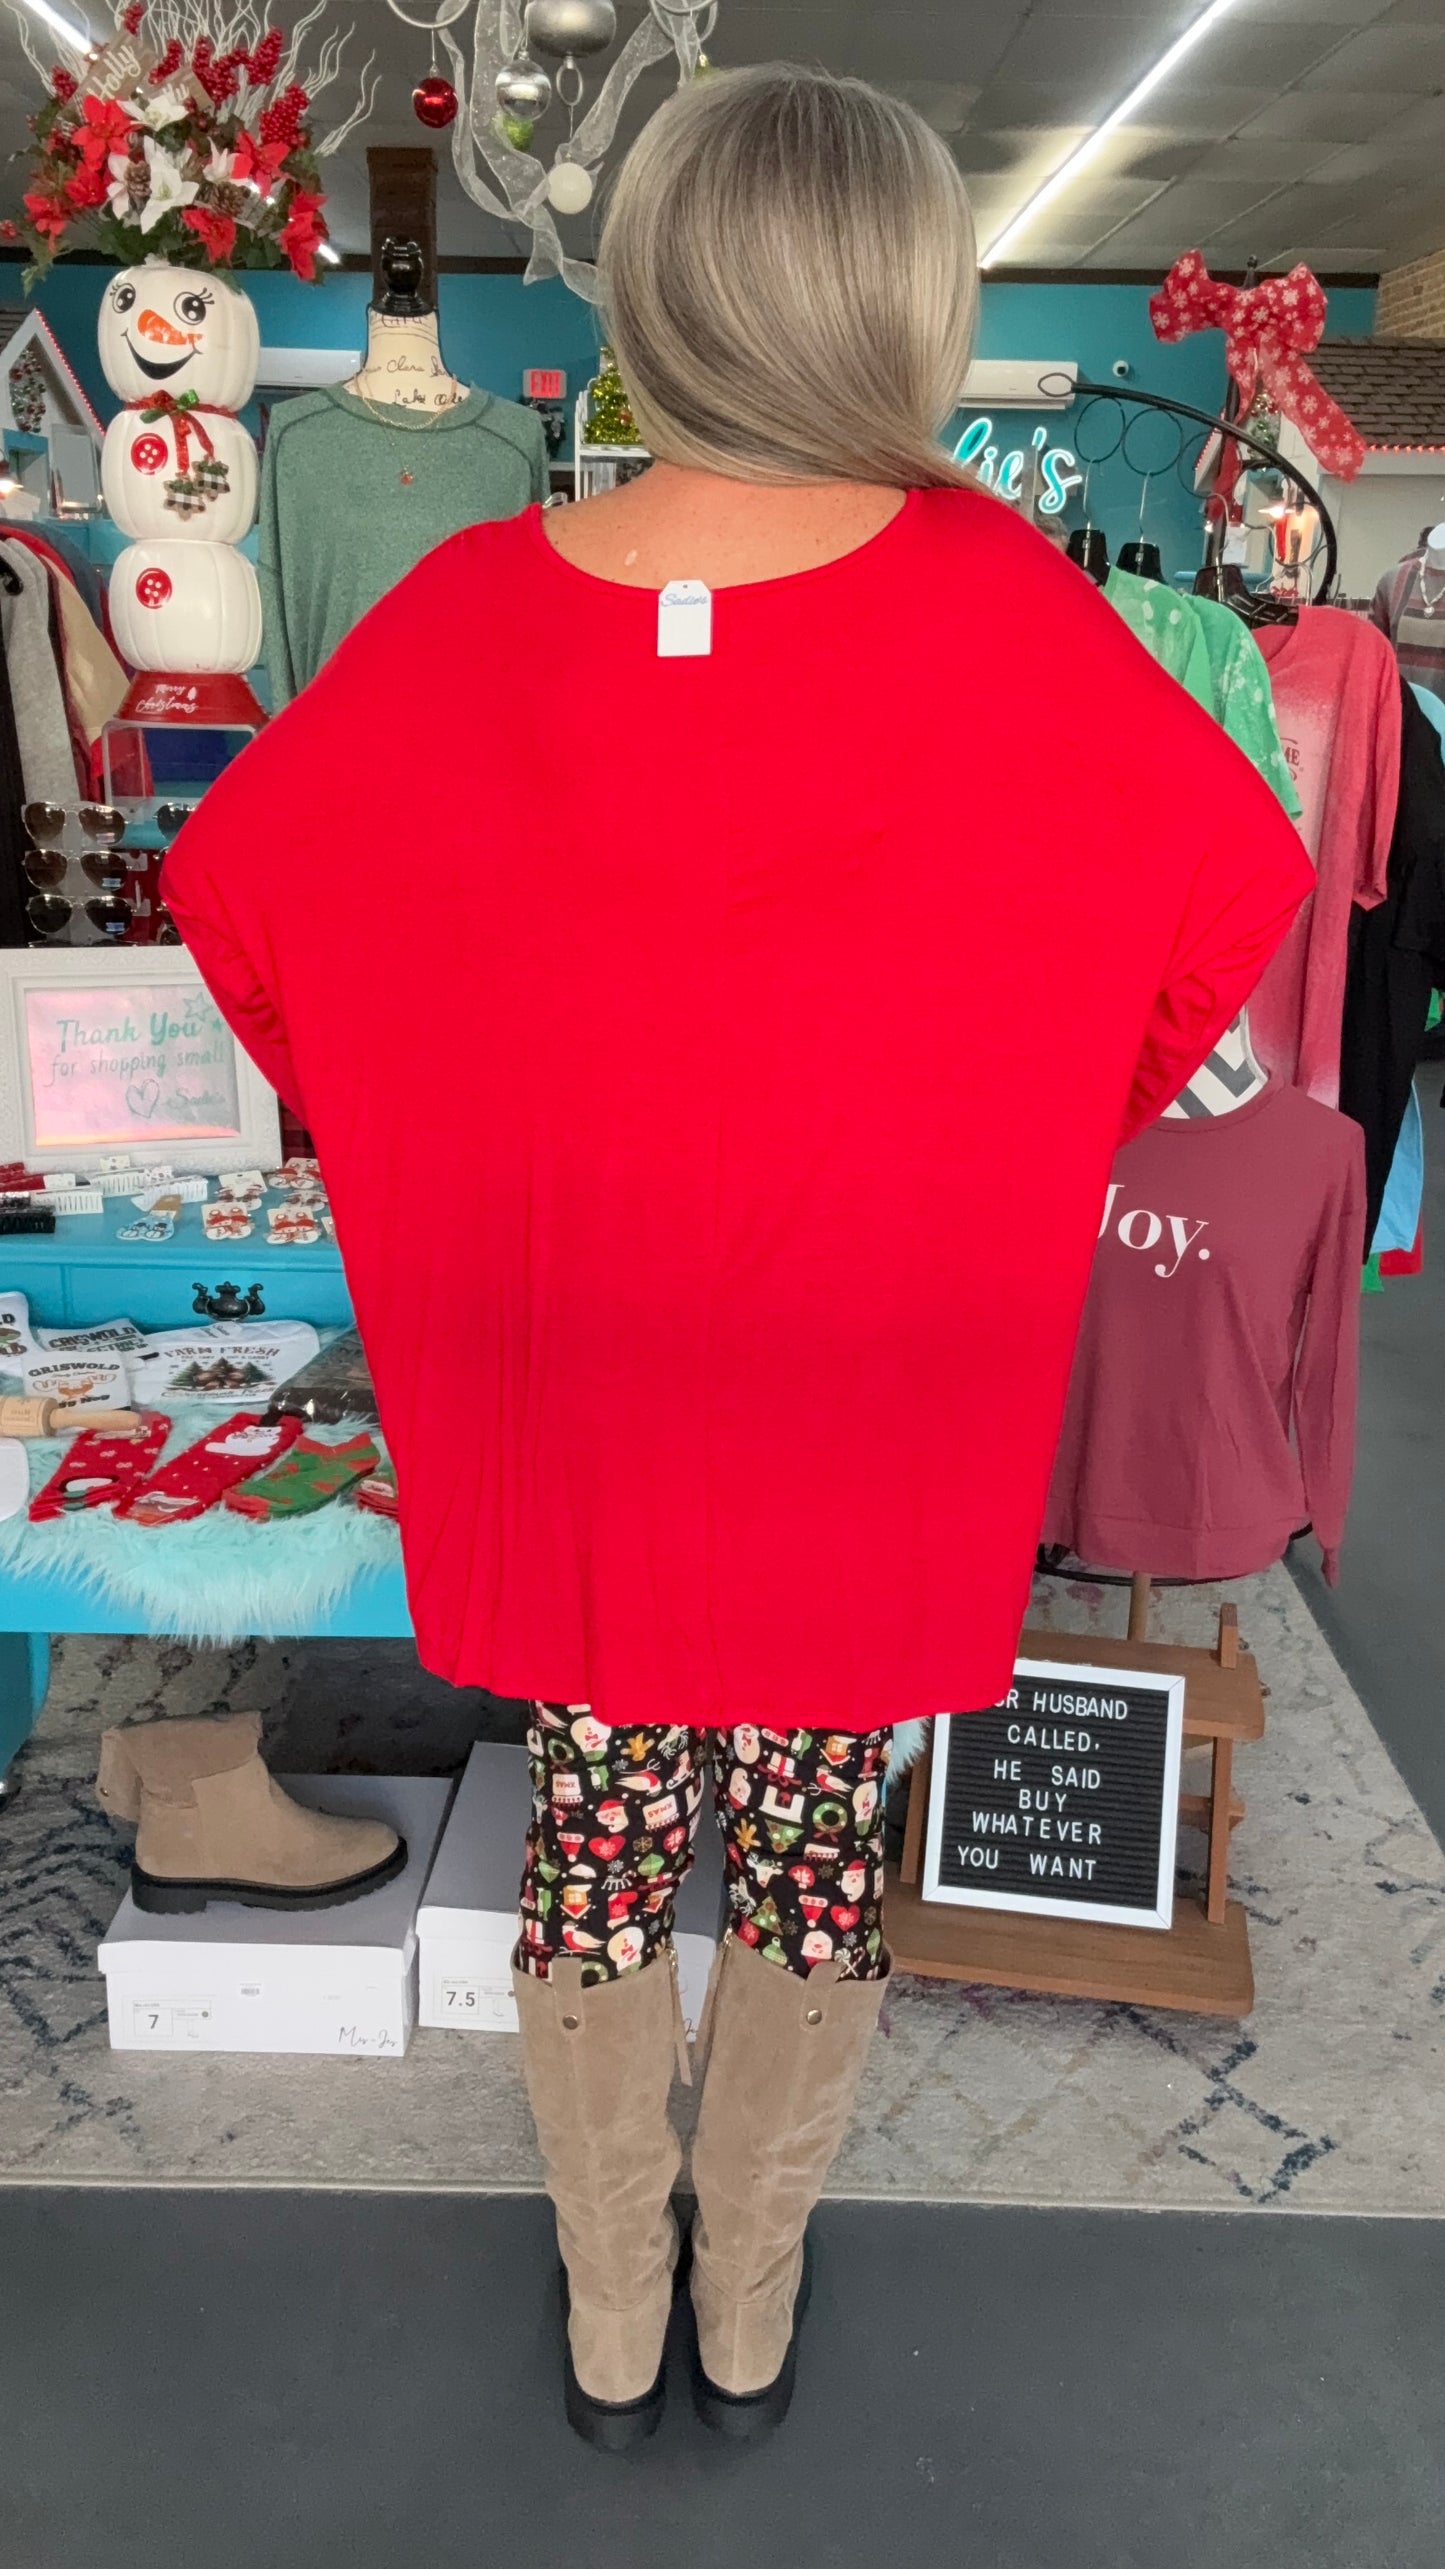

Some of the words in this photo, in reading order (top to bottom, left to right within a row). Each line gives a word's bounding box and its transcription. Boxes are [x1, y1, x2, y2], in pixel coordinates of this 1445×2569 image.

[56, 1017, 138, 1053] Thank
[150, 1011, 198, 1046] You
[43, 1054, 77, 1088] for
[90, 1049, 167, 1079] shopping
[177, 1040, 226, 1066] small
[1098, 1183, 1210, 1278] Joy.
[48, 1326, 137, 1349] GRISWOLD
[28, 1362, 120, 1377] GRISWOLD
[1033, 1691, 1128, 1720] HUSBAND
[1007, 1725, 1100, 1752] CALLED,
[993, 1759, 1022, 1781] HE
[1051, 1765, 1100, 1790] SAID
[1018, 1789, 1067, 1813] BUY
[972, 1811, 1101, 1845] WHATEVER
[957, 1846, 999, 1869] YOU
[1029, 1854, 1096, 1880] WANT
[446, 1991, 476, 2007] 7.5
[147, 2014, 159, 2029] 7
